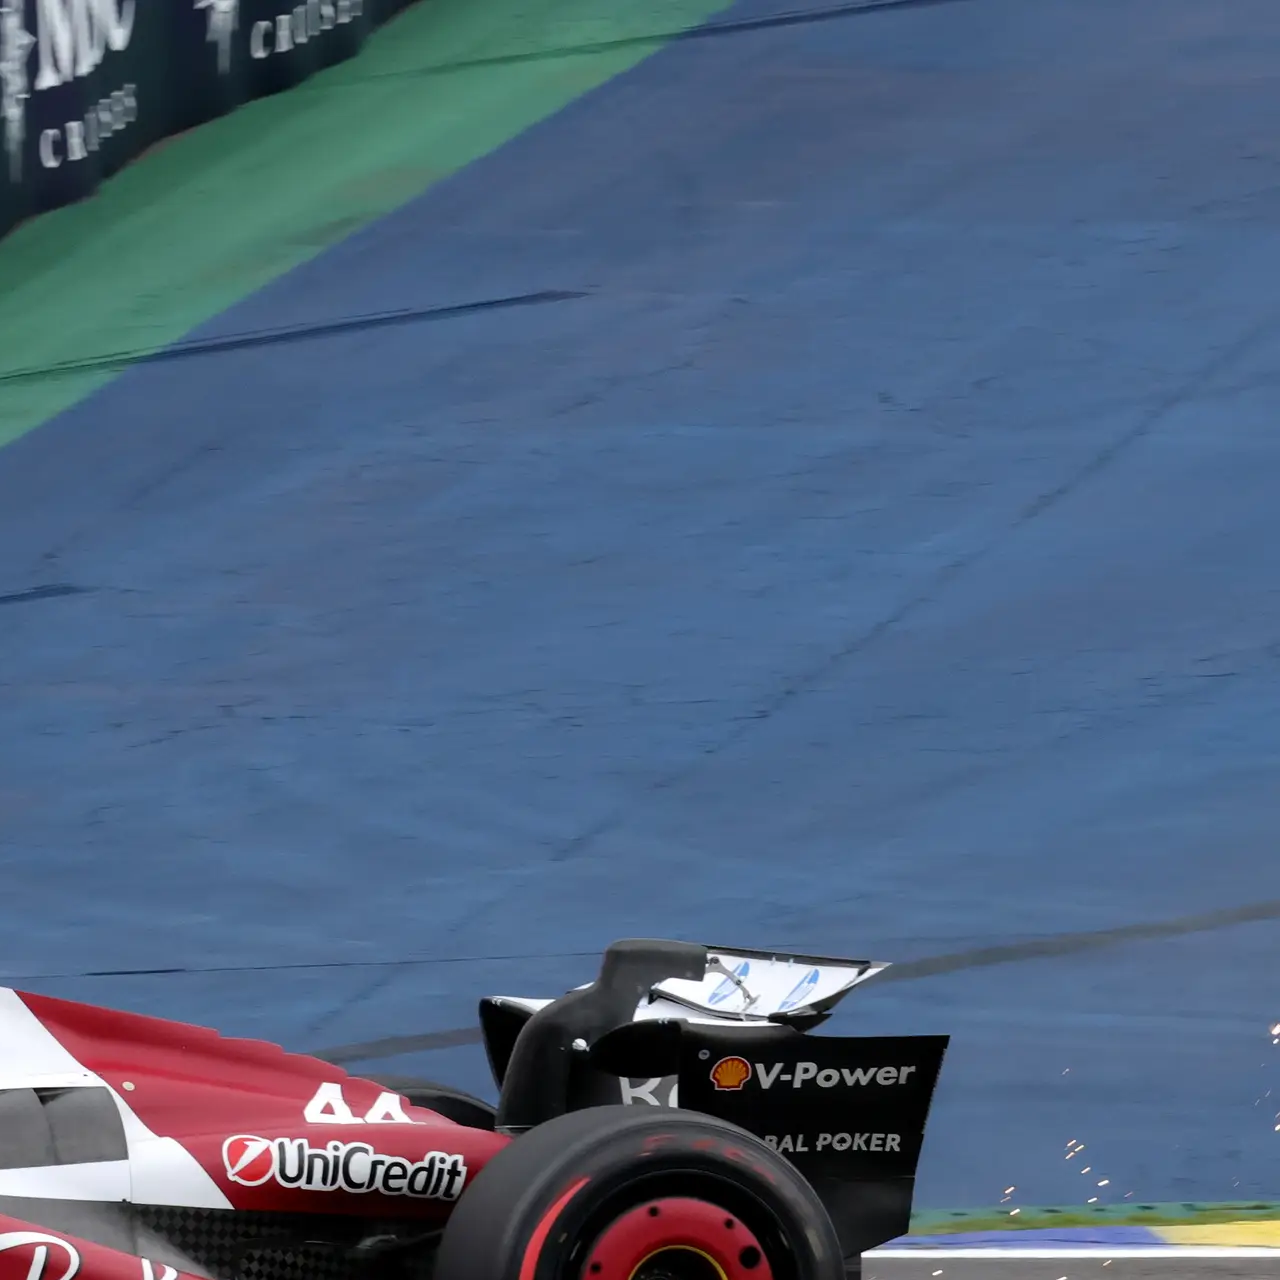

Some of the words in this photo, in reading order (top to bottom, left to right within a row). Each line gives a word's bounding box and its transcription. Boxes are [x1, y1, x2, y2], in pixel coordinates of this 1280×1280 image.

[755, 1061, 916, 1089] V-Power
[303, 1082, 428, 1125] 44
[815, 1133, 901, 1152] POKER
[277, 1140, 464, 1198] UniCredit
